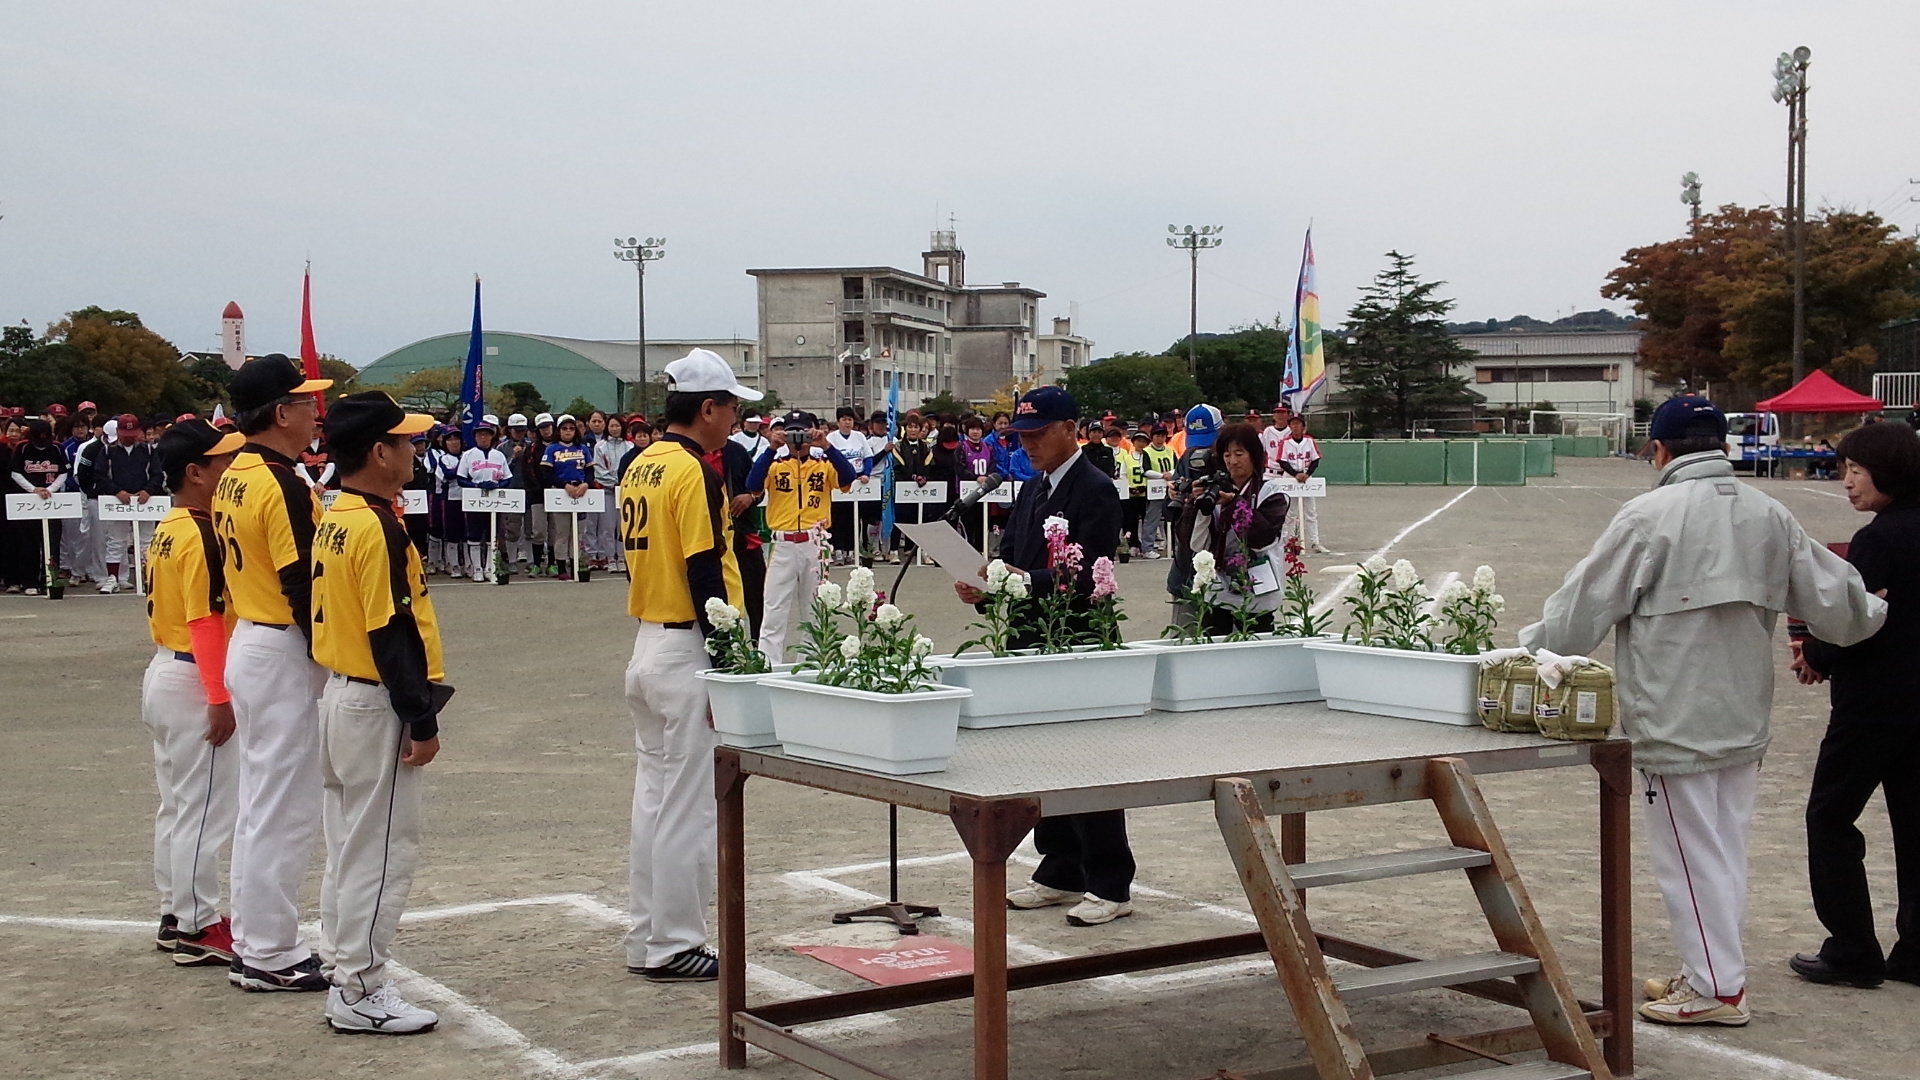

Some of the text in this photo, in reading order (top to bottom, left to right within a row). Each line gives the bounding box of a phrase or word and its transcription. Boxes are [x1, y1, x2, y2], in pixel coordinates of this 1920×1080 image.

[972, 458, 987, 476] 10
[1132, 466, 1143, 484] 5
[903, 488, 938, 497] かぐや姫
[1151, 485, 1168, 495] 横浜
[16, 501, 73, 512] アン、グレー
[468, 499, 520, 509] マドンナーズ
[555, 497, 595, 506] こぶし
[808, 495, 821, 509] 39
[104, 503, 166, 513] 雫石よしゃれ
[622, 495, 649, 551] 22
[857, 947, 951, 966] JOYFUL
